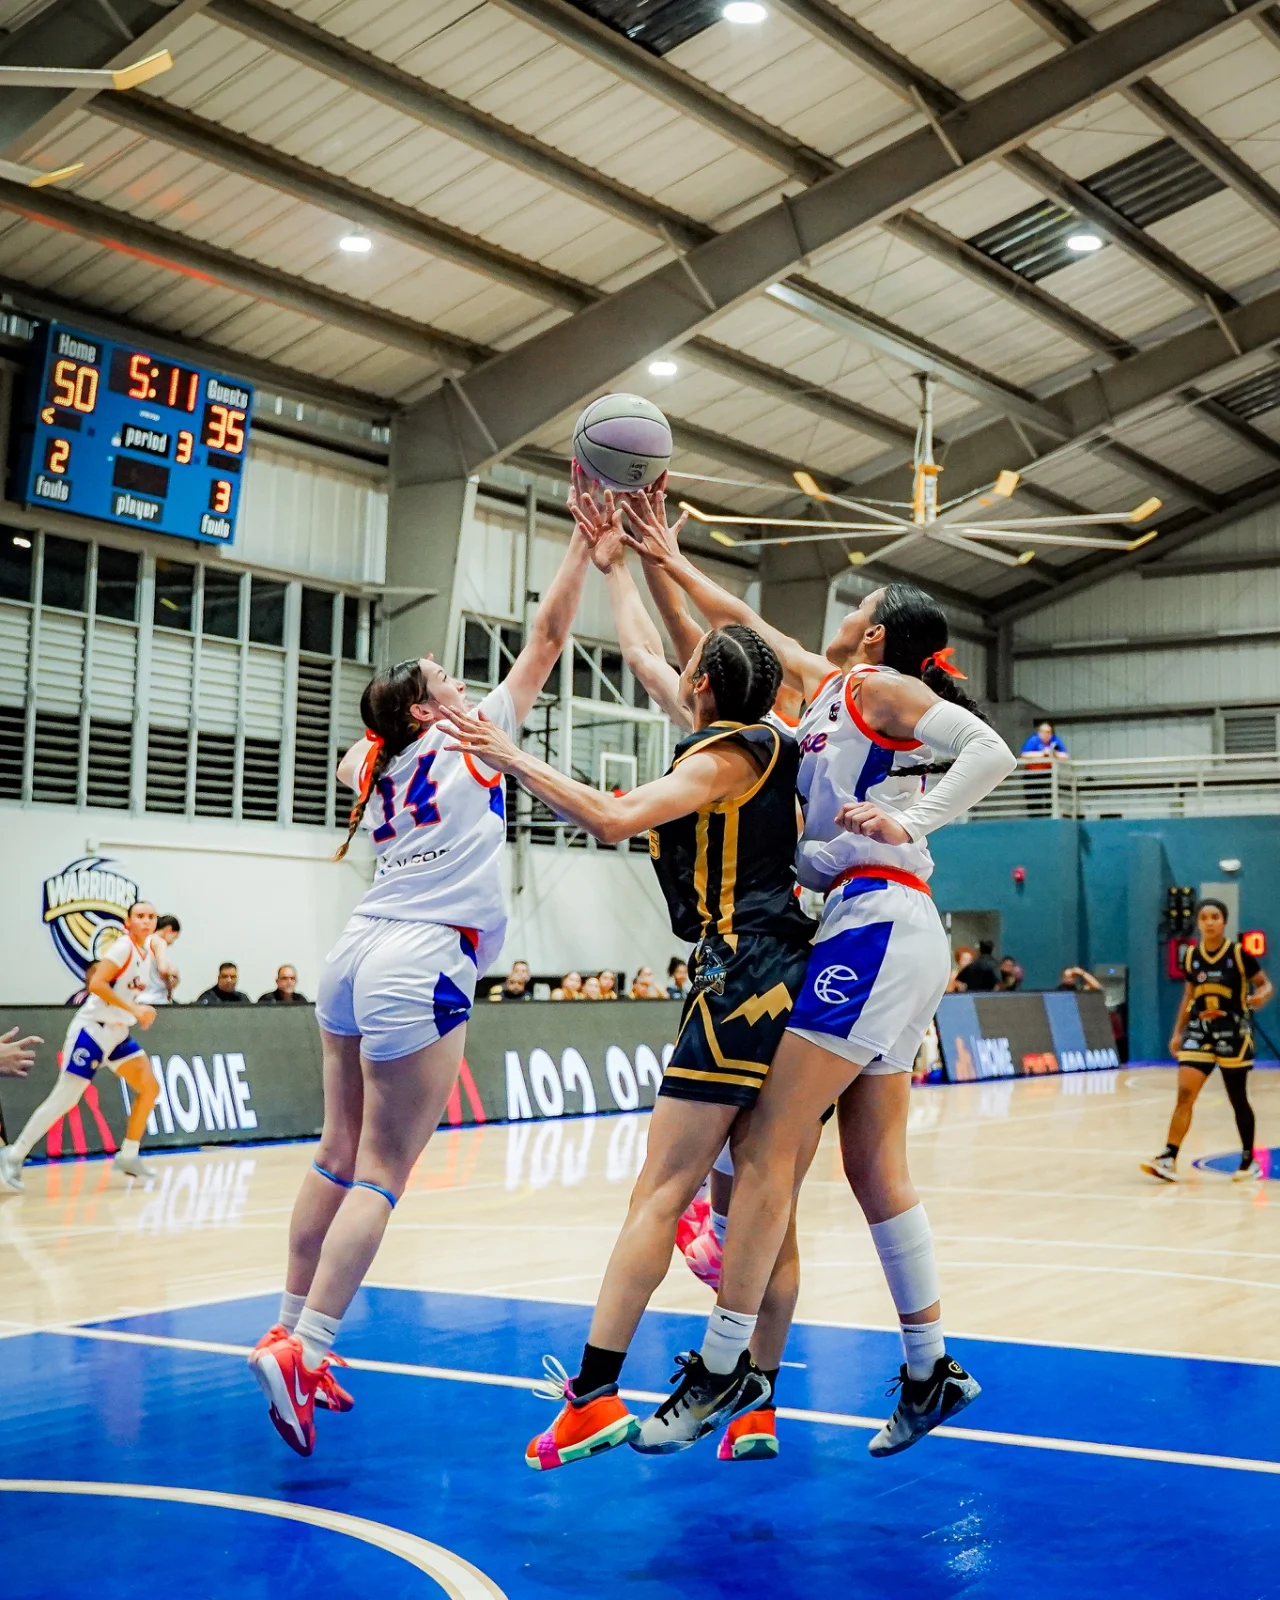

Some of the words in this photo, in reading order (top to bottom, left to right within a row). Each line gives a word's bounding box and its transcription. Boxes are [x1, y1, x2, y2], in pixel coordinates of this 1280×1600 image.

[58, 333, 97, 363] Home
[53, 359, 99, 413] 50
[128, 353, 199, 412] 5:11
[206, 379, 248, 409] Guests
[125, 427, 168, 453] period
[206, 404, 246, 454] 35
[50, 438, 70, 474] 2
[176, 430, 194, 464] 3
[35, 475, 69, 501] fouls
[214, 480, 231, 513] 3
[116, 494, 158, 520] player
[201, 514, 230, 538] fouls
[373, 750, 441, 843] 14
[46, 869, 137, 909] WARRIORS
[147, 1052, 257, 1136] HOME
